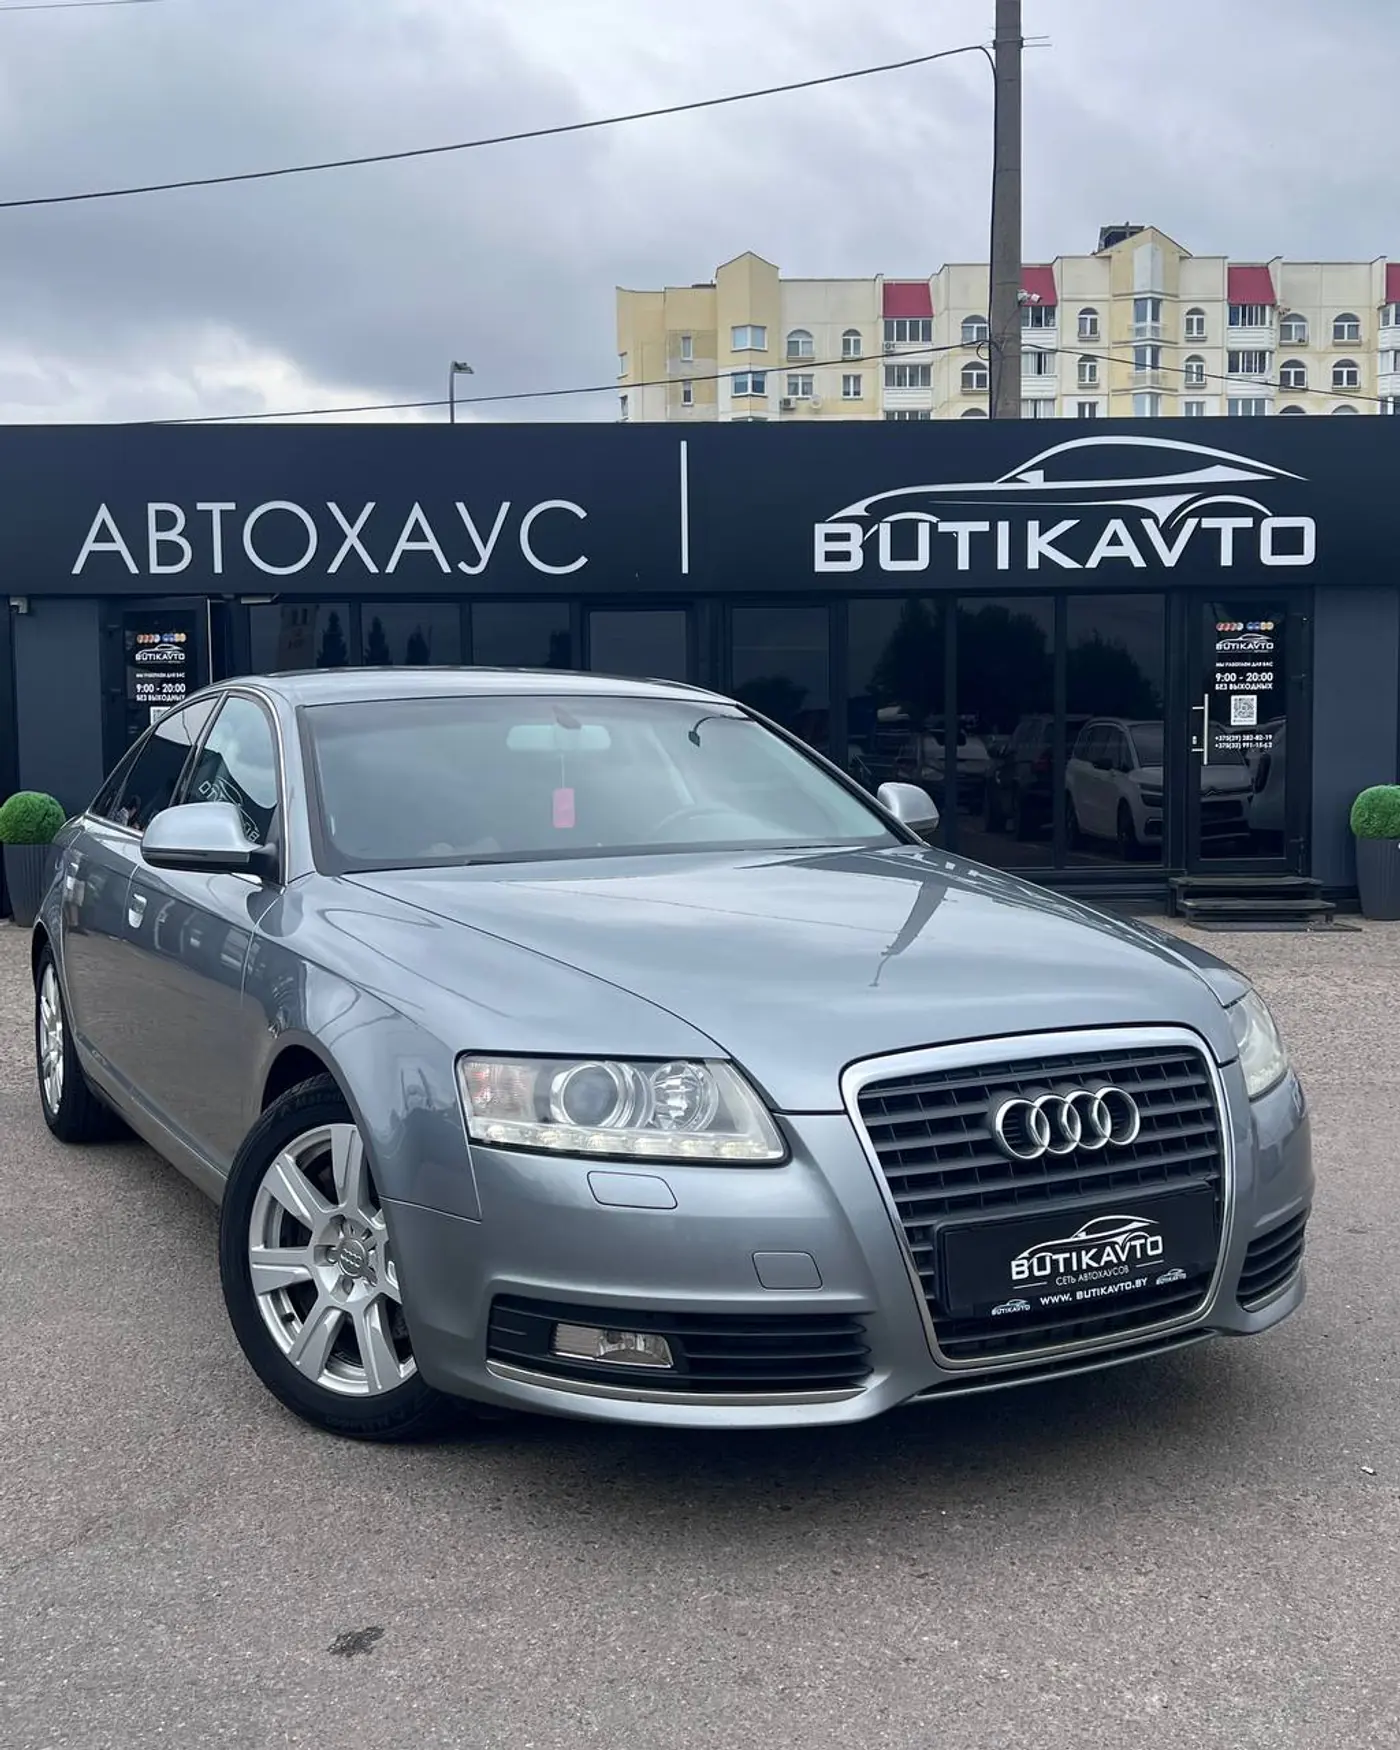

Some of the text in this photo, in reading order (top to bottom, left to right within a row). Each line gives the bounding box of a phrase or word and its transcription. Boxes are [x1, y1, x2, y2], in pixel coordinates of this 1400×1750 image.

[72, 499, 588, 575] АВТОХАУС
[814, 515, 1316, 573] BUTIKAVTO
[135, 652, 185, 660] BUTIKAVTO
[1216, 642, 1274, 650] BUTIKAVTO
[136, 683, 154, 693] 9:00
[162, 683, 186, 693] 20:00
[1215, 672, 1237, 682] 9:00
[1246, 672, 1273, 682] 20:00
[1011, 1235, 1163, 1281] BUTIKAVTO
[1055, 1265, 1130, 1287] СЕТЬ АВТОХАУСОВ
[1039, 1277, 1148, 1306] WWW. BUTIKAVTO.BY
